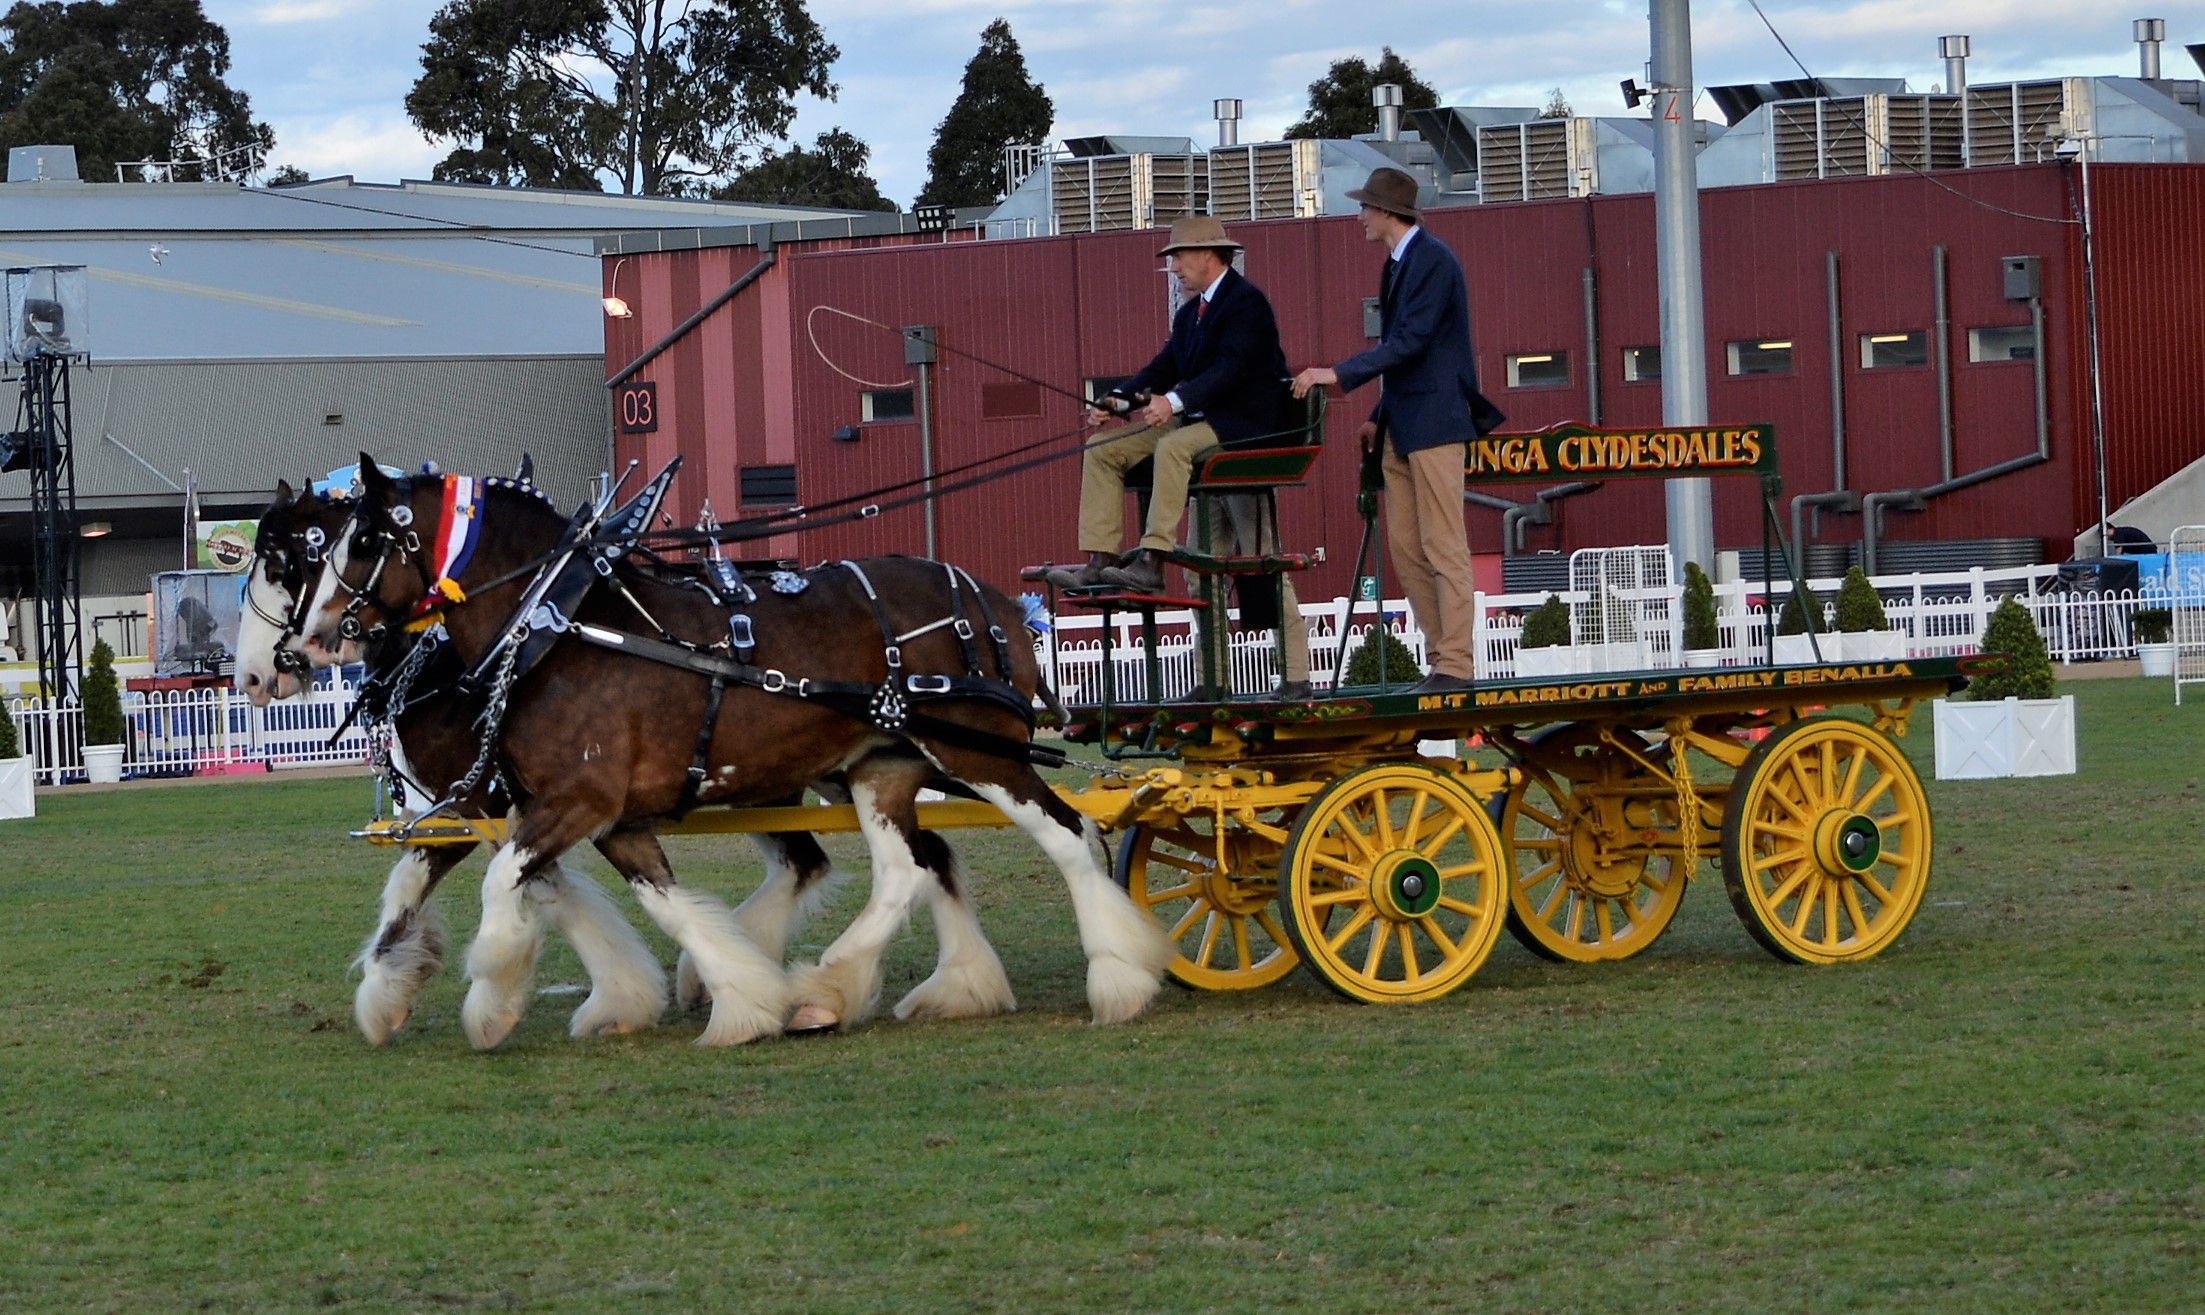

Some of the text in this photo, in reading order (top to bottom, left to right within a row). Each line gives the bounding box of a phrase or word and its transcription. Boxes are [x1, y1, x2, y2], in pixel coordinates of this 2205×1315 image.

[1664, 96, 1681, 125] 4
[623, 389, 652, 426] 03
[1557, 431, 1761, 472] CLYDESDALES
[1475, 682, 1632, 706] MARRIOTT
[1638, 681, 1667, 696] AND
[1678, 671, 1777, 692] FAMILY
[1783, 663, 1912, 685] BENALLA
